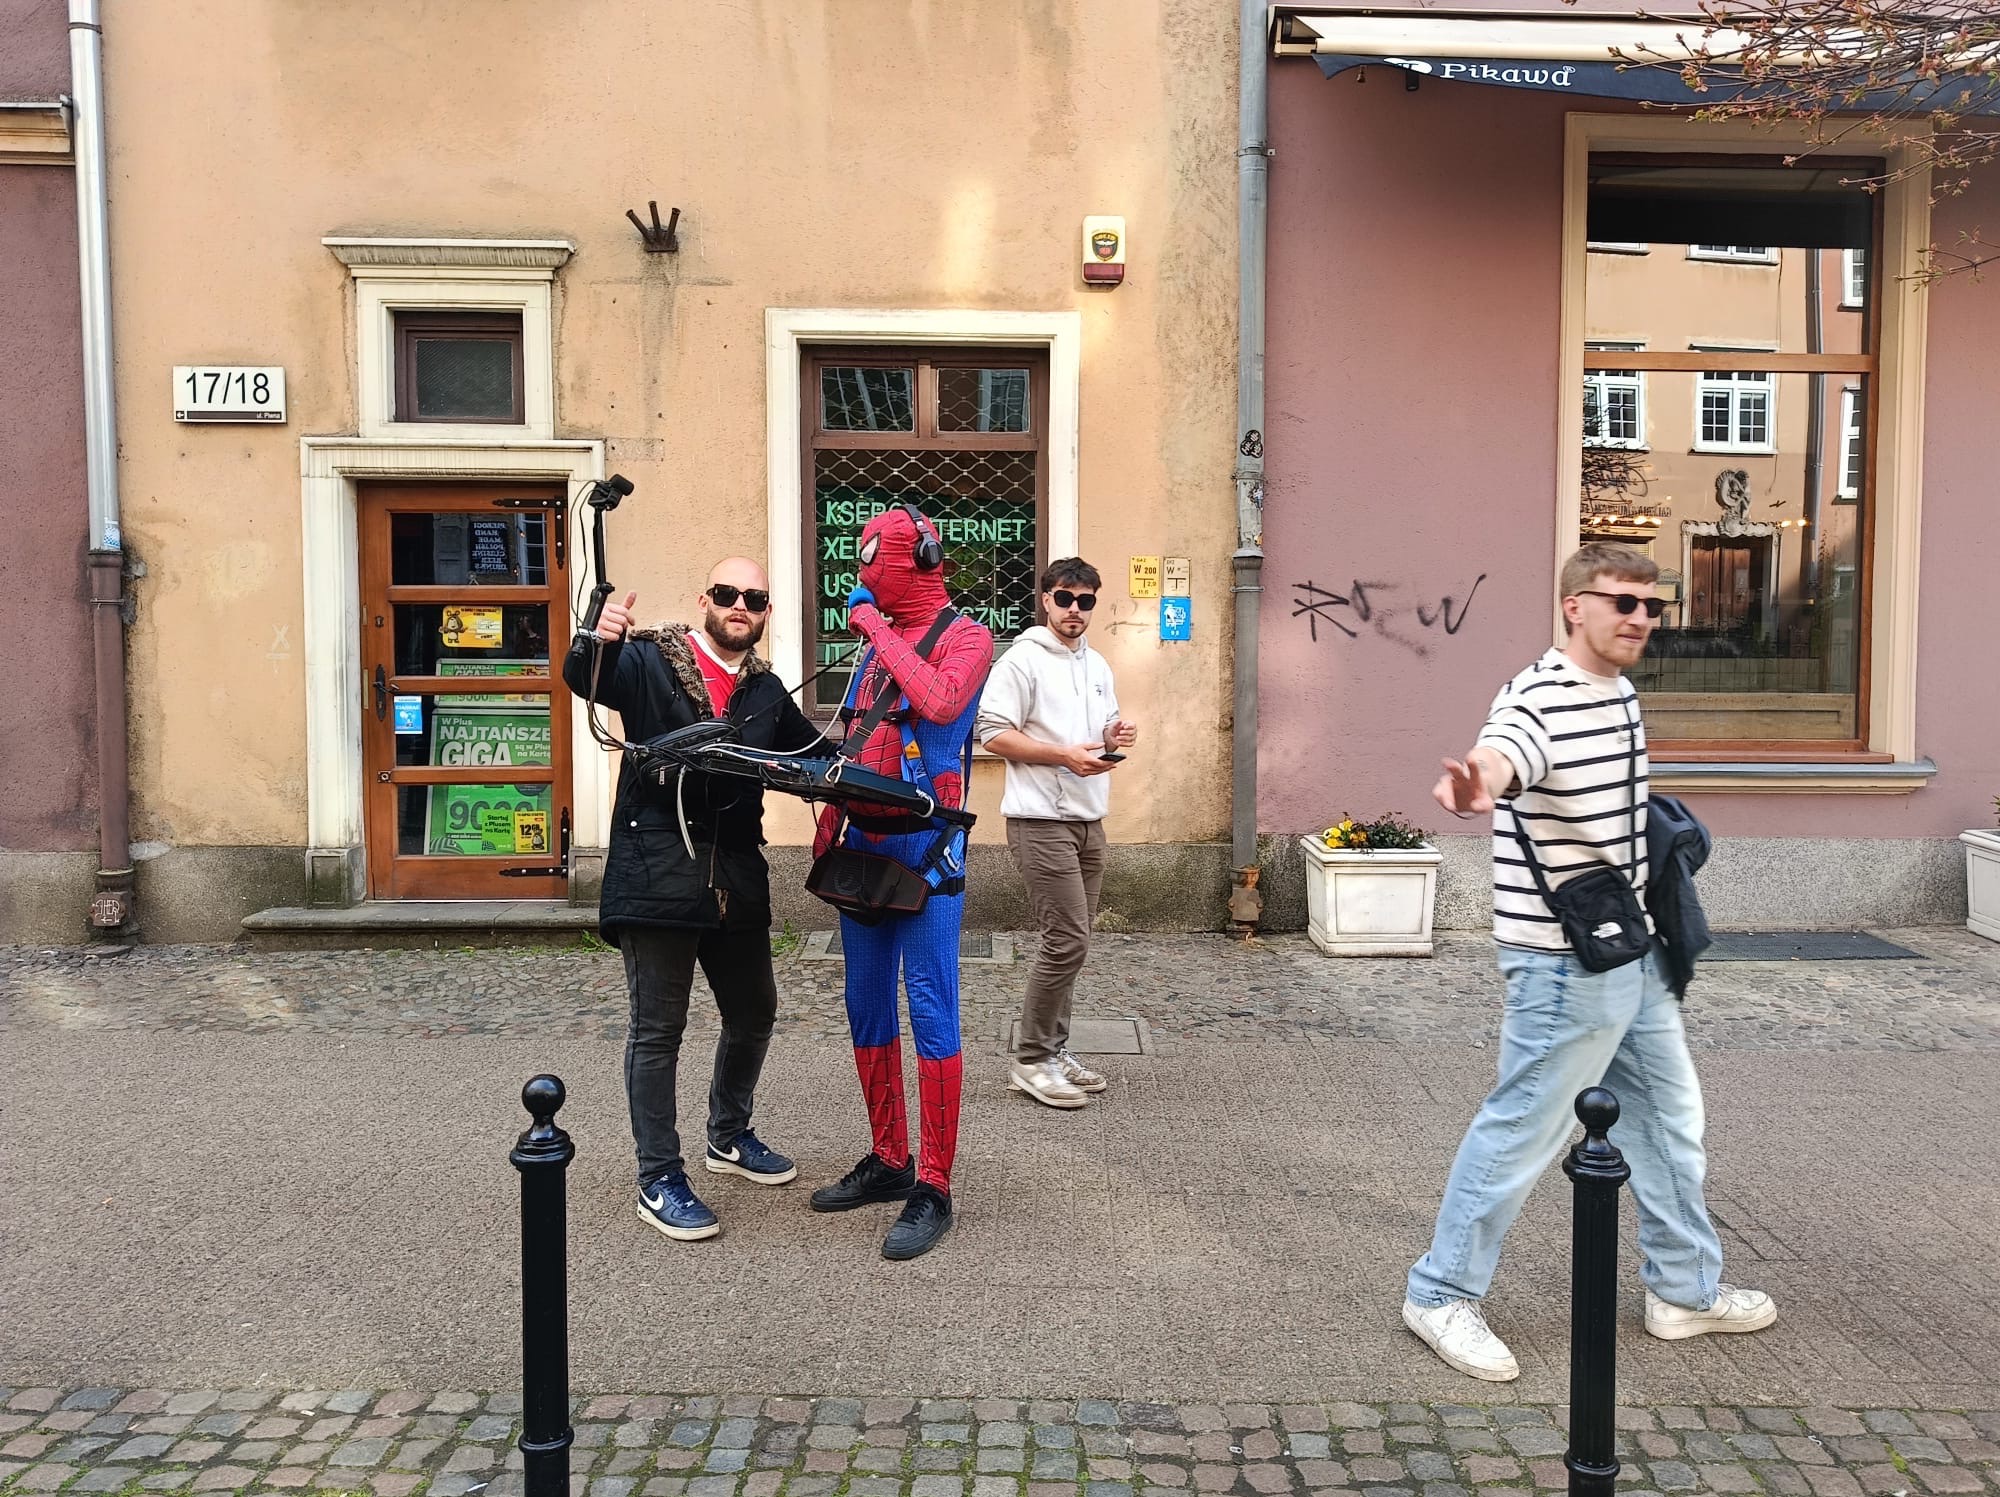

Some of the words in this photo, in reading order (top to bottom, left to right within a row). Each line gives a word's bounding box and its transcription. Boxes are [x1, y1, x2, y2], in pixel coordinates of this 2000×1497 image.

[186, 372, 270, 405] 17/18
[931, 517, 1027, 542] TERNET
[1133, 564, 1142, 575] W
[1144, 567, 1157, 576] 200
[1166, 566, 1175, 575] W
[442, 742, 512, 766] GIGA
